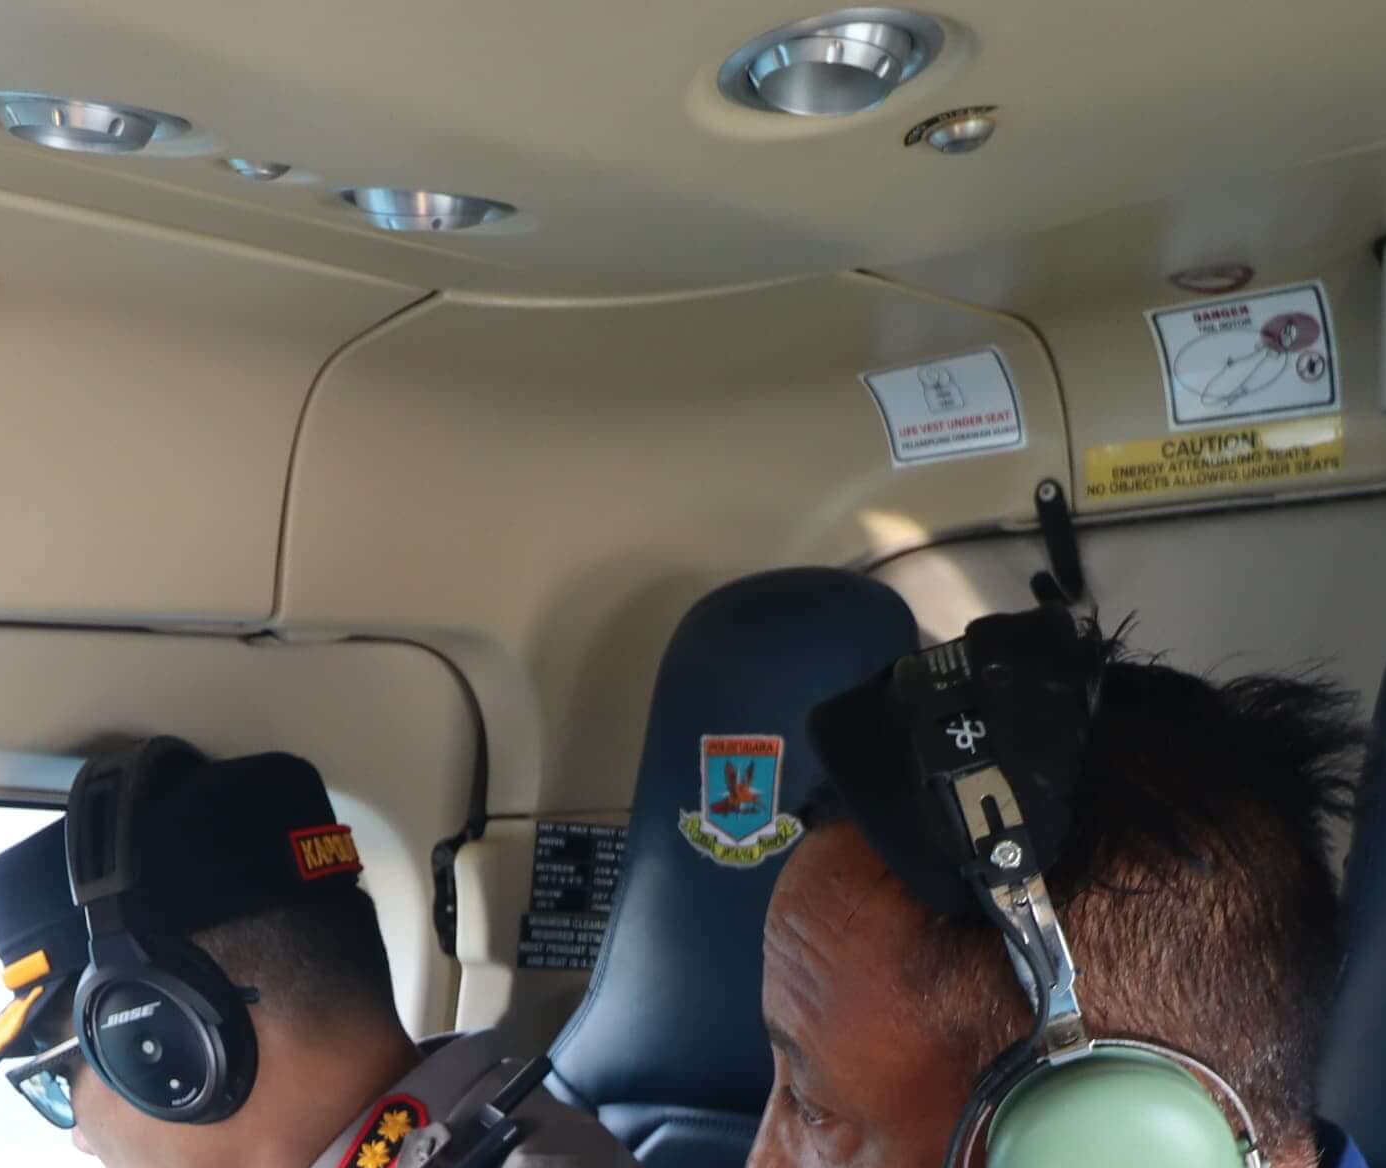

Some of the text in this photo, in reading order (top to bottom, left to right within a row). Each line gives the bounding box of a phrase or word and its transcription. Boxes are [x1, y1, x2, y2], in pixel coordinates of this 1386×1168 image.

[1193, 304, 1251, 323] DANGER
[921, 420, 944, 435] VEST
[948, 414, 982, 430] UNDER
[986, 409, 1012, 425] SEAT
[1161, 430, 1256, 459] CAUTION
[1087, 456, 1341, 497] NO OBJECTS ALLOWED UNDER SEATS
[1112, 462, 1164, 480] ENERGY
[101, 1001, 162, 1029] BOSE
